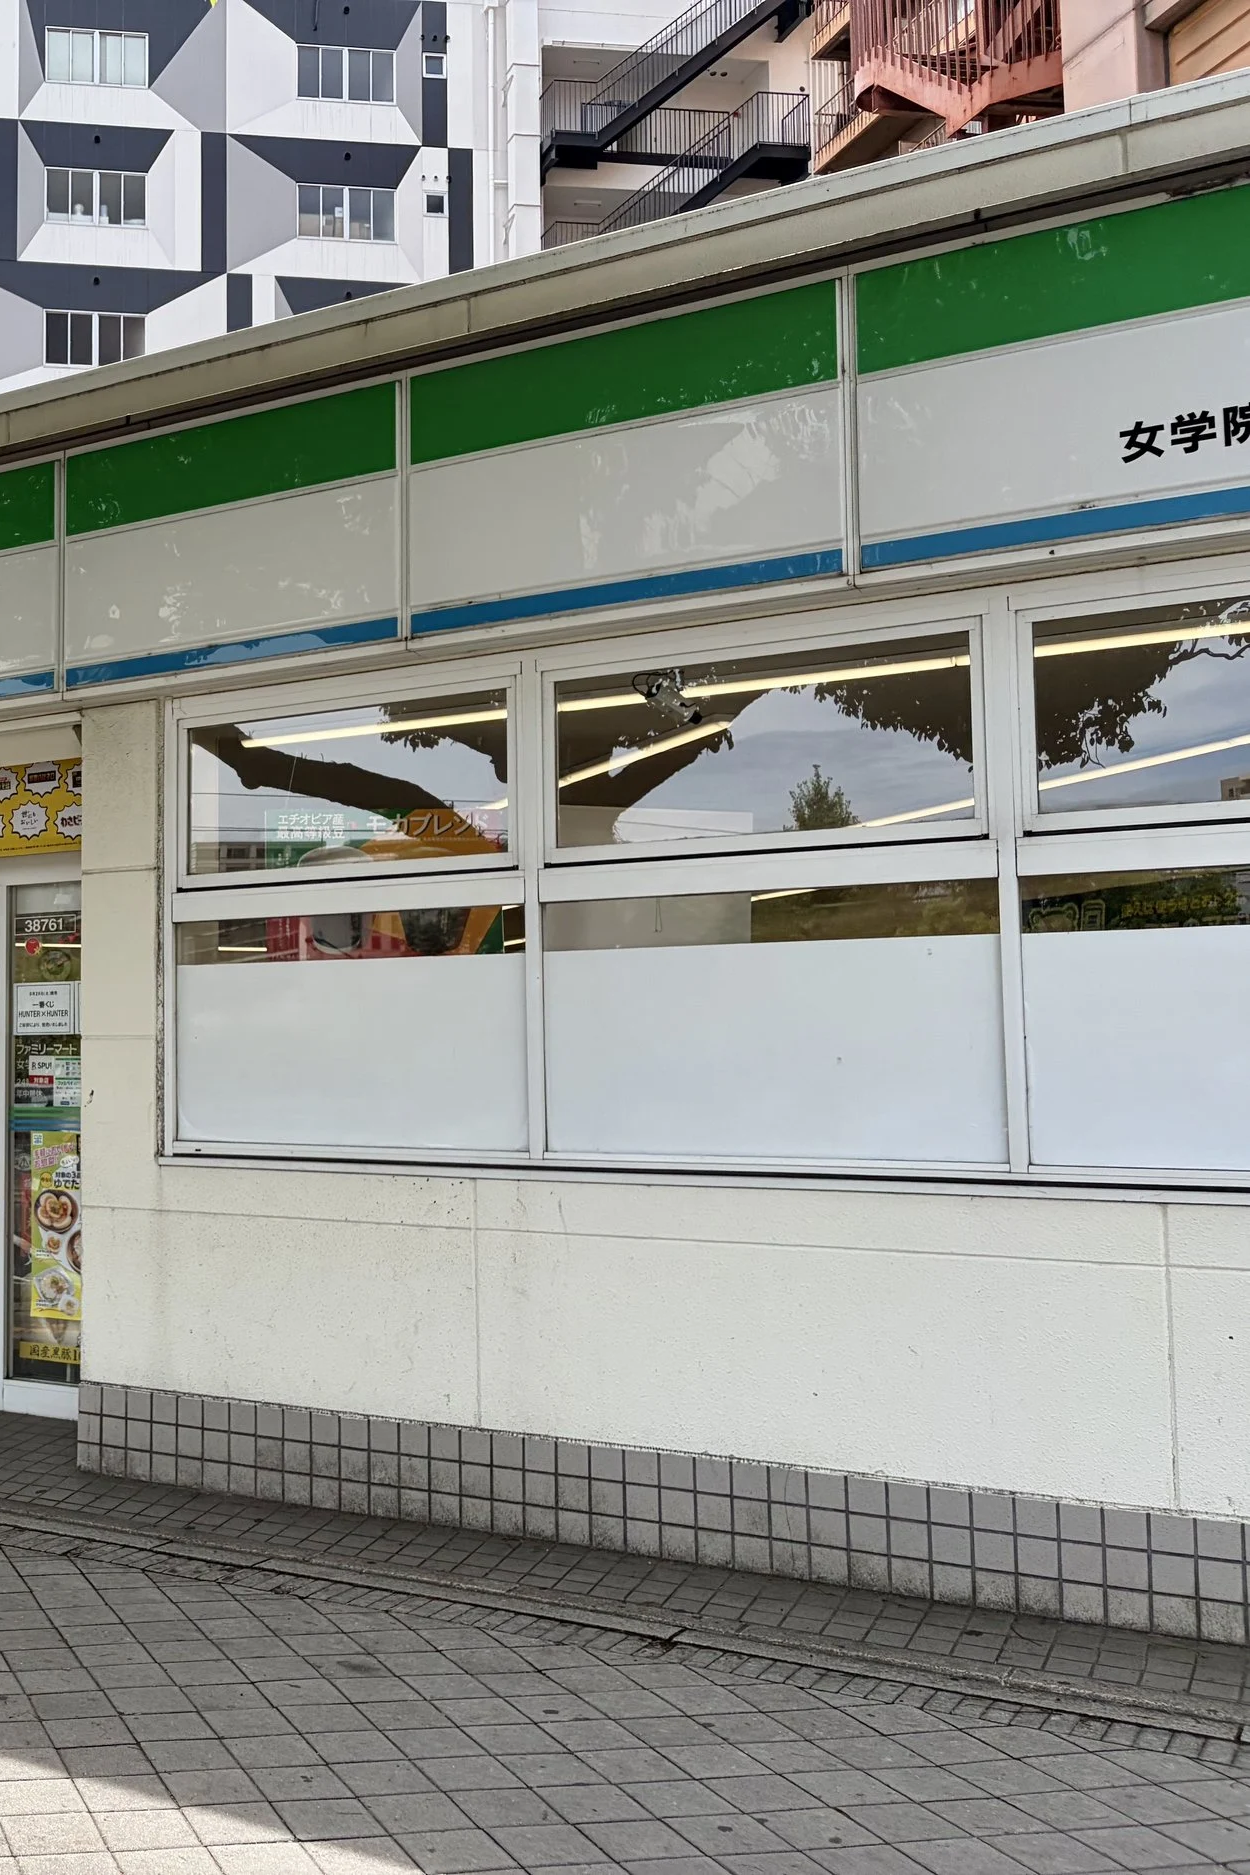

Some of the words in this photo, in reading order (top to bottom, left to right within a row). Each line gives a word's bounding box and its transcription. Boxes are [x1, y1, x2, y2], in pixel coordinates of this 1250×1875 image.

[1119, 402, 1250, 464] 女学院
[278, 813, 345, 826] エチオピア産
[366, 812, 489, 837] モカブレンド
[277, 826, 345, 839] 最高等級豆
[25, 918, 64, 932] 38761
[32, 1001, 54, 1009] 一番くじ
[16, 1043, 78, 1055] ファミリーマート
